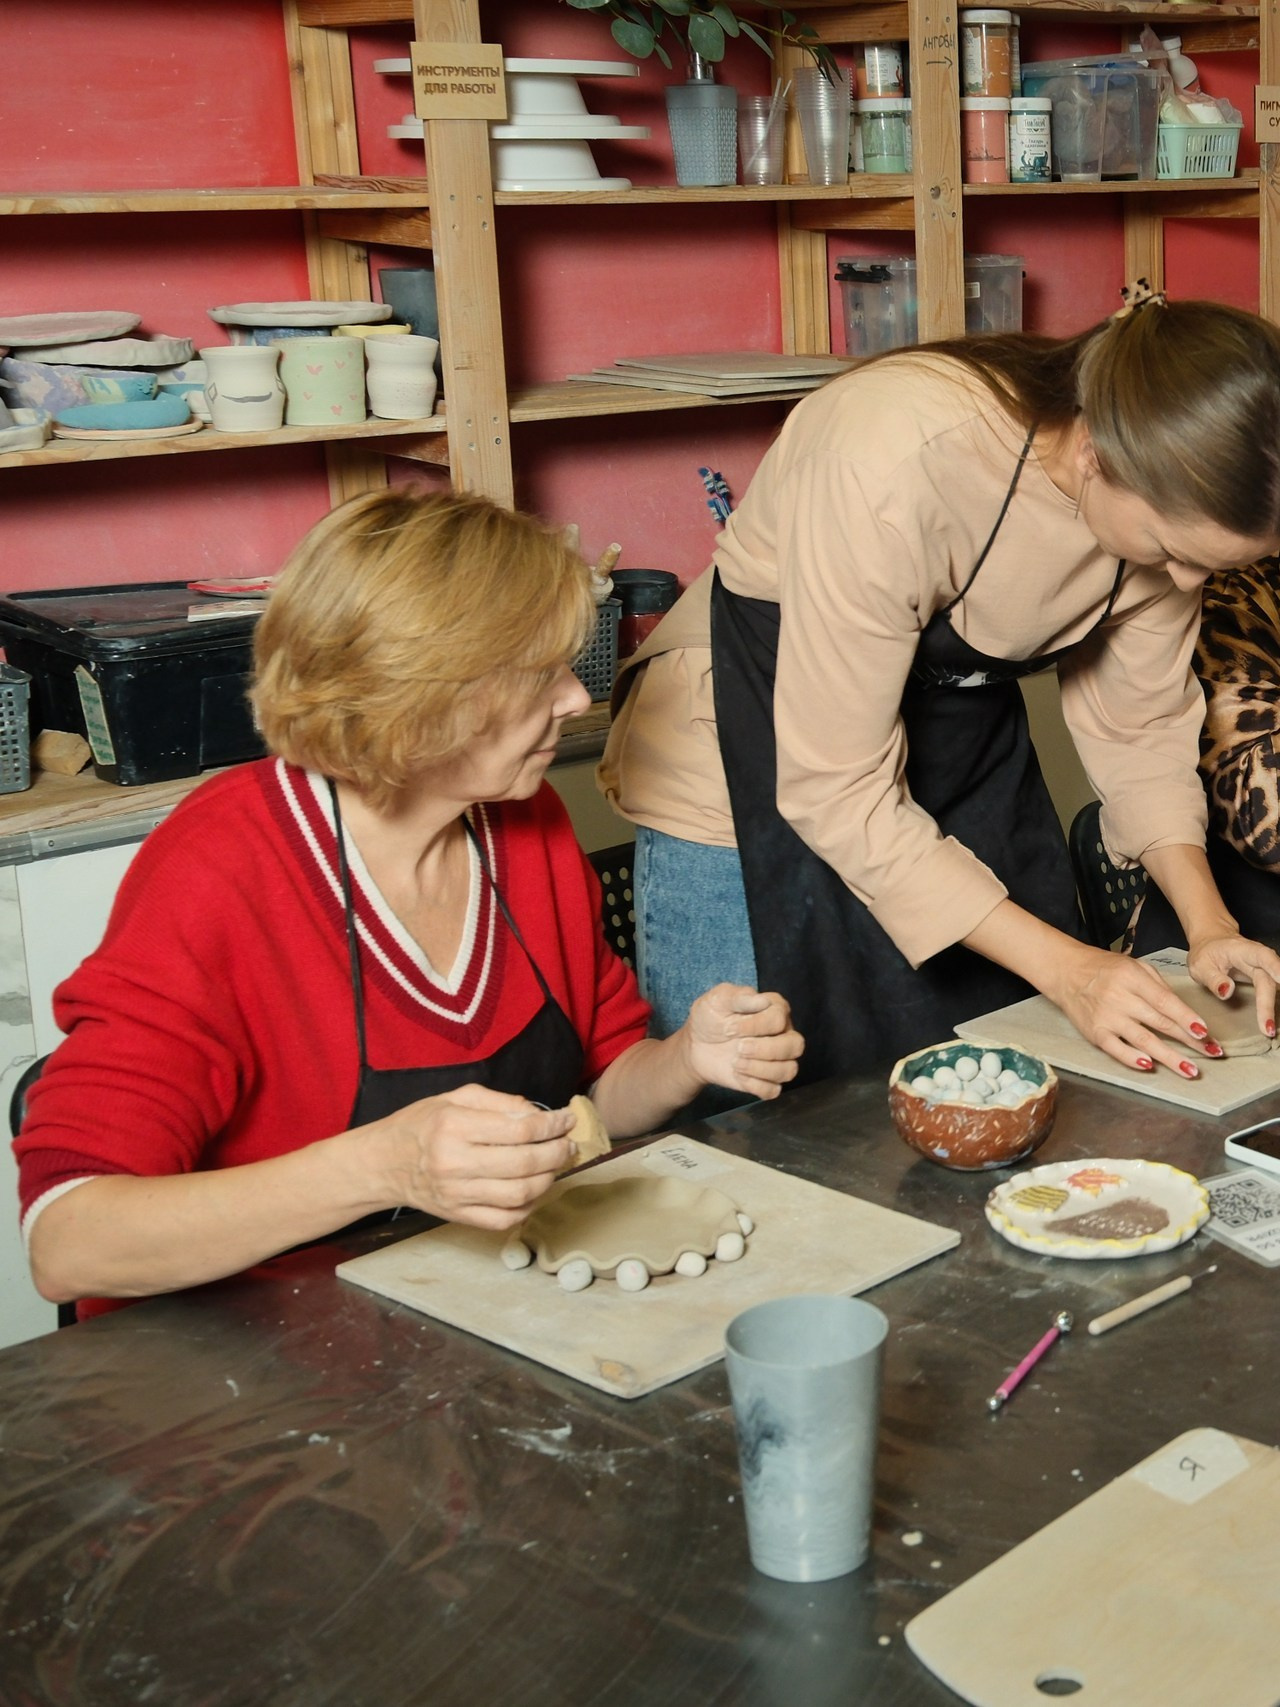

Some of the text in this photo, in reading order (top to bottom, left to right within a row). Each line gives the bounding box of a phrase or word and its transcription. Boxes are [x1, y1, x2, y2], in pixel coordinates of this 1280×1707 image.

[417, 65, 500, 77] ИНСТРУМЕНТЫ
[423, 83, 496, 95] ДЛЯ РАБОТЫ
